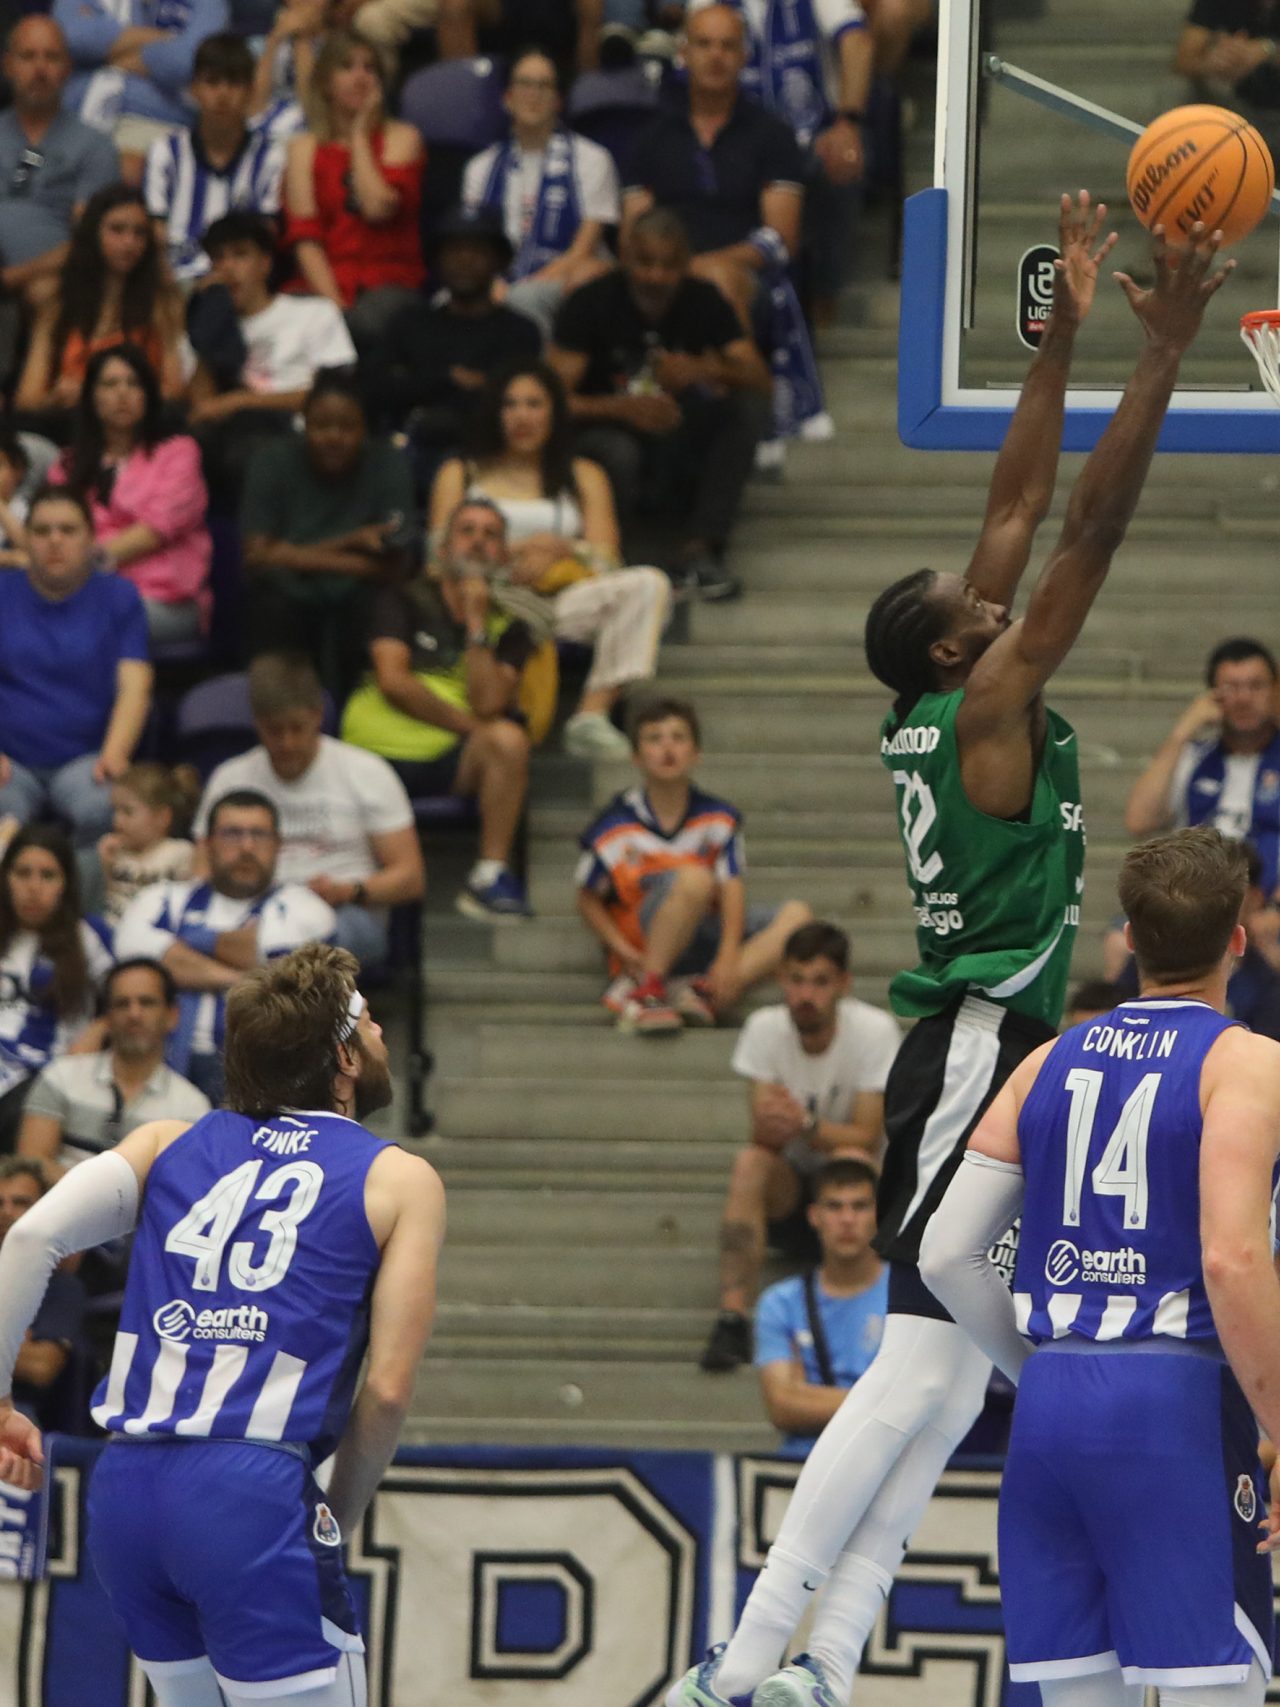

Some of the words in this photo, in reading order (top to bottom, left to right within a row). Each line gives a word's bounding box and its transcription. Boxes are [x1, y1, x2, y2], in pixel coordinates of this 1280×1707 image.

[1133, 139, 1197, 214] Wilson
[1083, 1026, 1178, 1060] CONKLIN
[252, 1126, 319, 1155] FINKE
[1063, 1068, 1162, 1230] 14
[165, 1158, 325, 1293] 43
[1081, 1247, 1146, 1274] earth
[1081, 1270, 1146, 1285] consulters
[196, 1305, 269, 1330] earth
[193, 1326, 267, 1342] consulters
